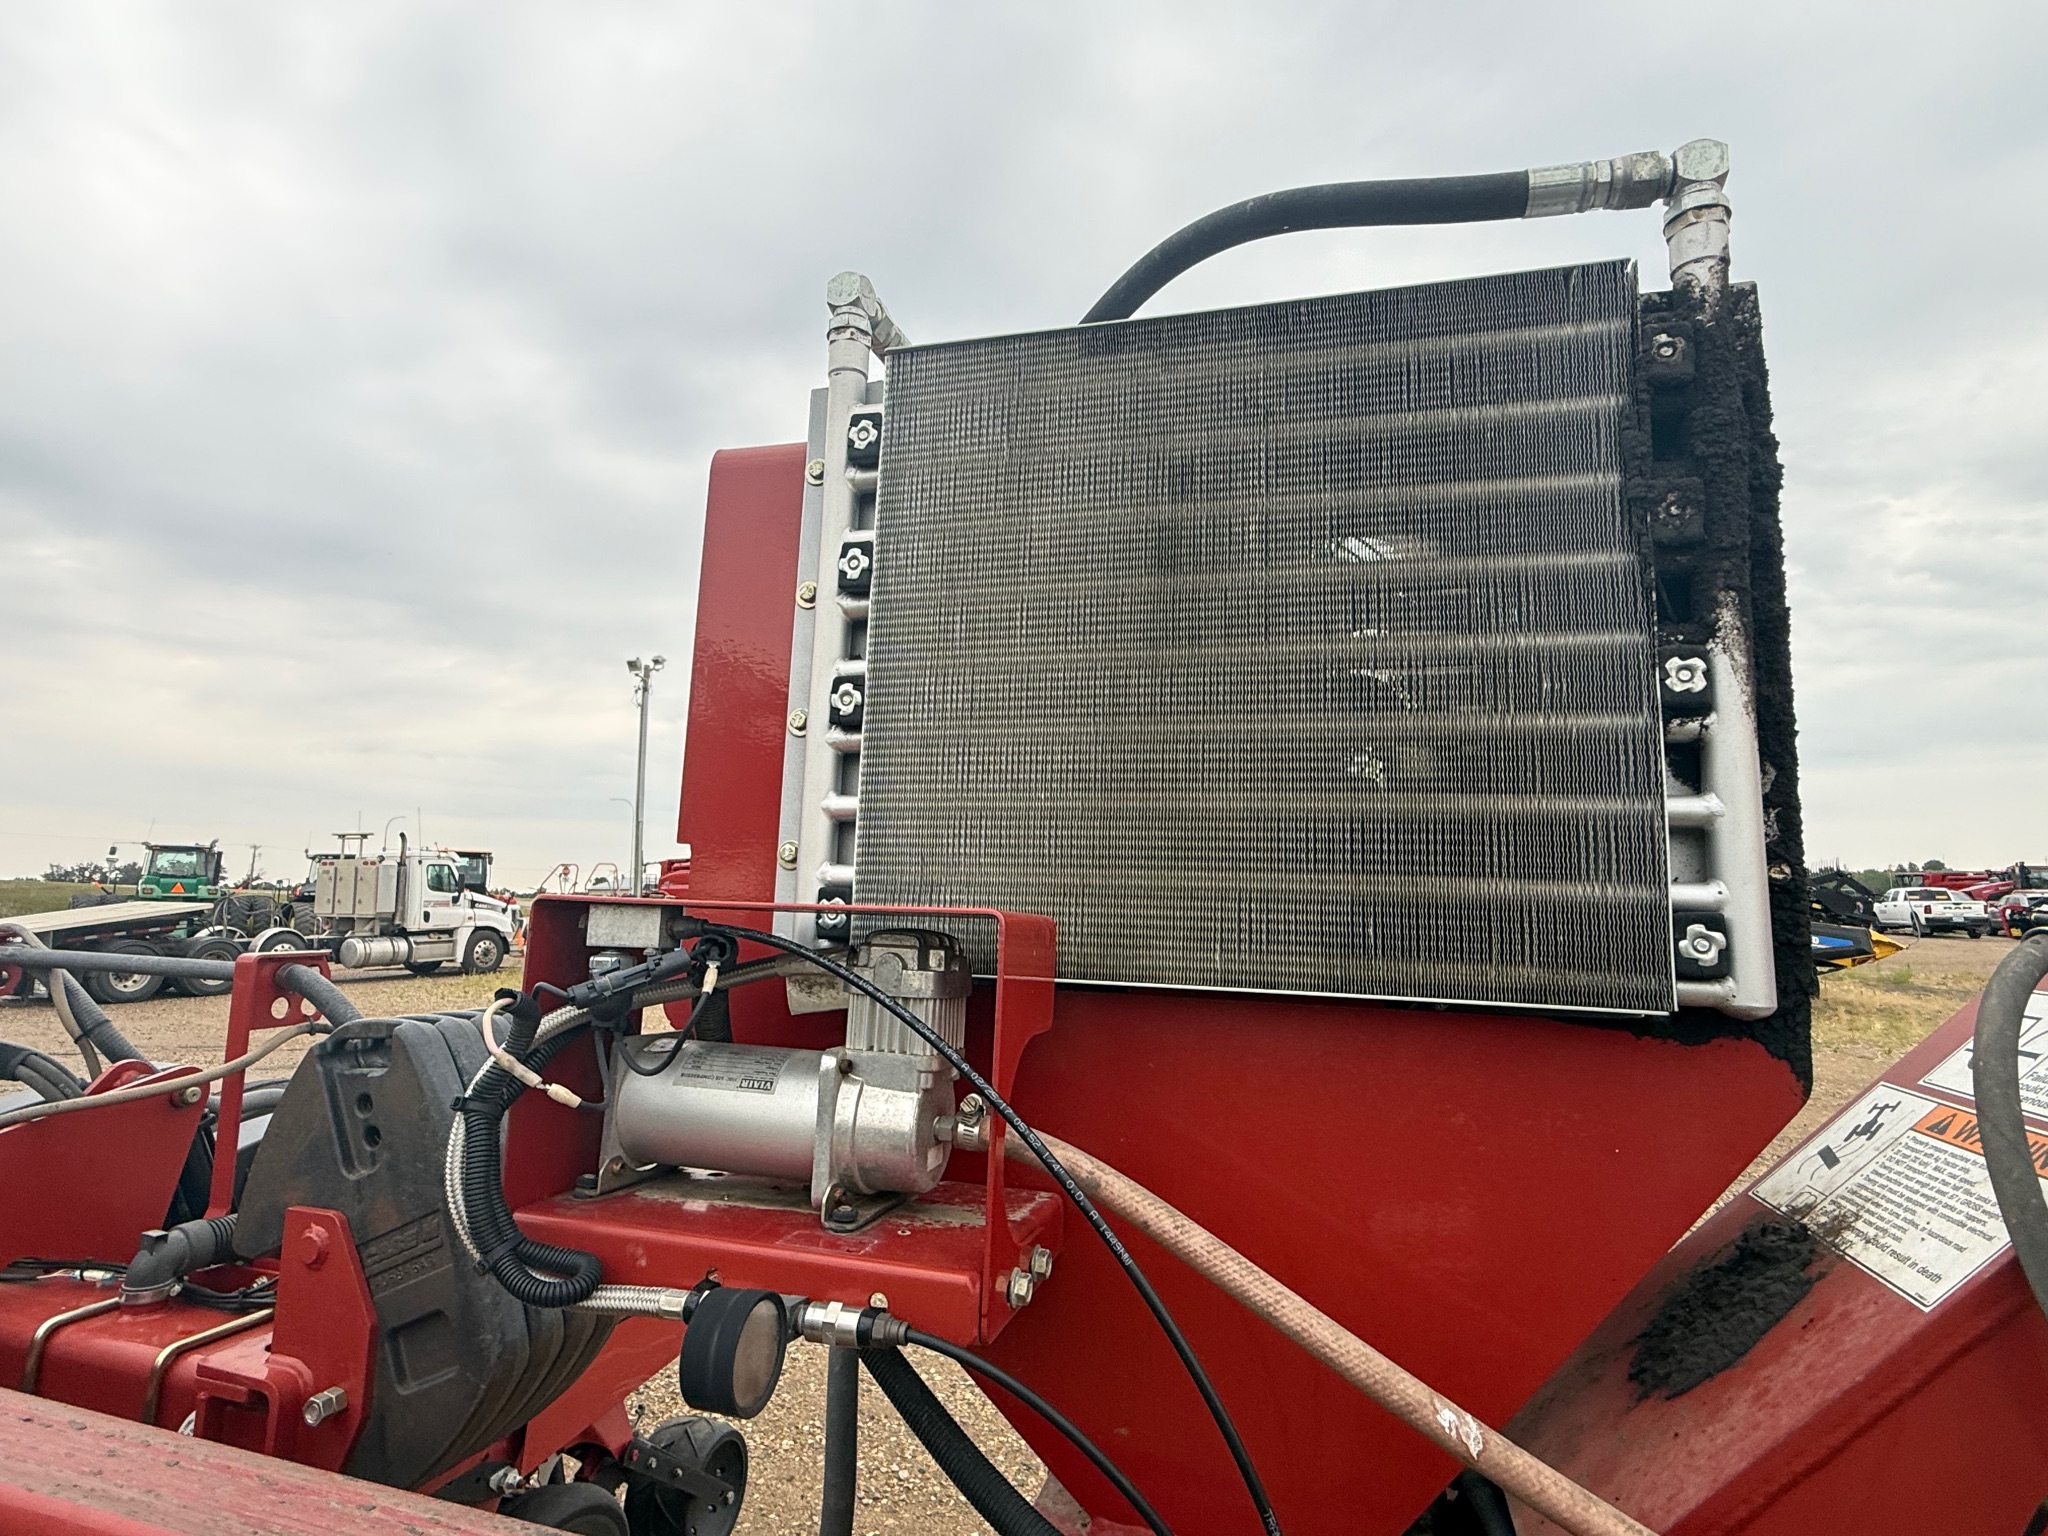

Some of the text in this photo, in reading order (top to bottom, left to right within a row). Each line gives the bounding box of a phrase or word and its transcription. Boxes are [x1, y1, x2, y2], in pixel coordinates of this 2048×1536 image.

[740, 1080, 772, 1090] VIAIR
[876, 990, 894, 1006] AND
[938, 1040, 962, 1063] TYPE
[960, 1061, 970, 1071] A
[968, 1071, 1014, 1116] 02/25/17
[1012, 1115, 1042, 1149] 05:52
[1042, 1150, 1064, 1176] 1/4"
[1064, 1178, 1088, 1206] O.D.
[1088, 1209, 1099, 1220] A
[1099, 1222, 1133, 1267] 1449NW
[1886, 1248, 1912, 1265] result
[1907, 1259, 1919, 1270] in
[1916, 1266, 1942, 1284] death
